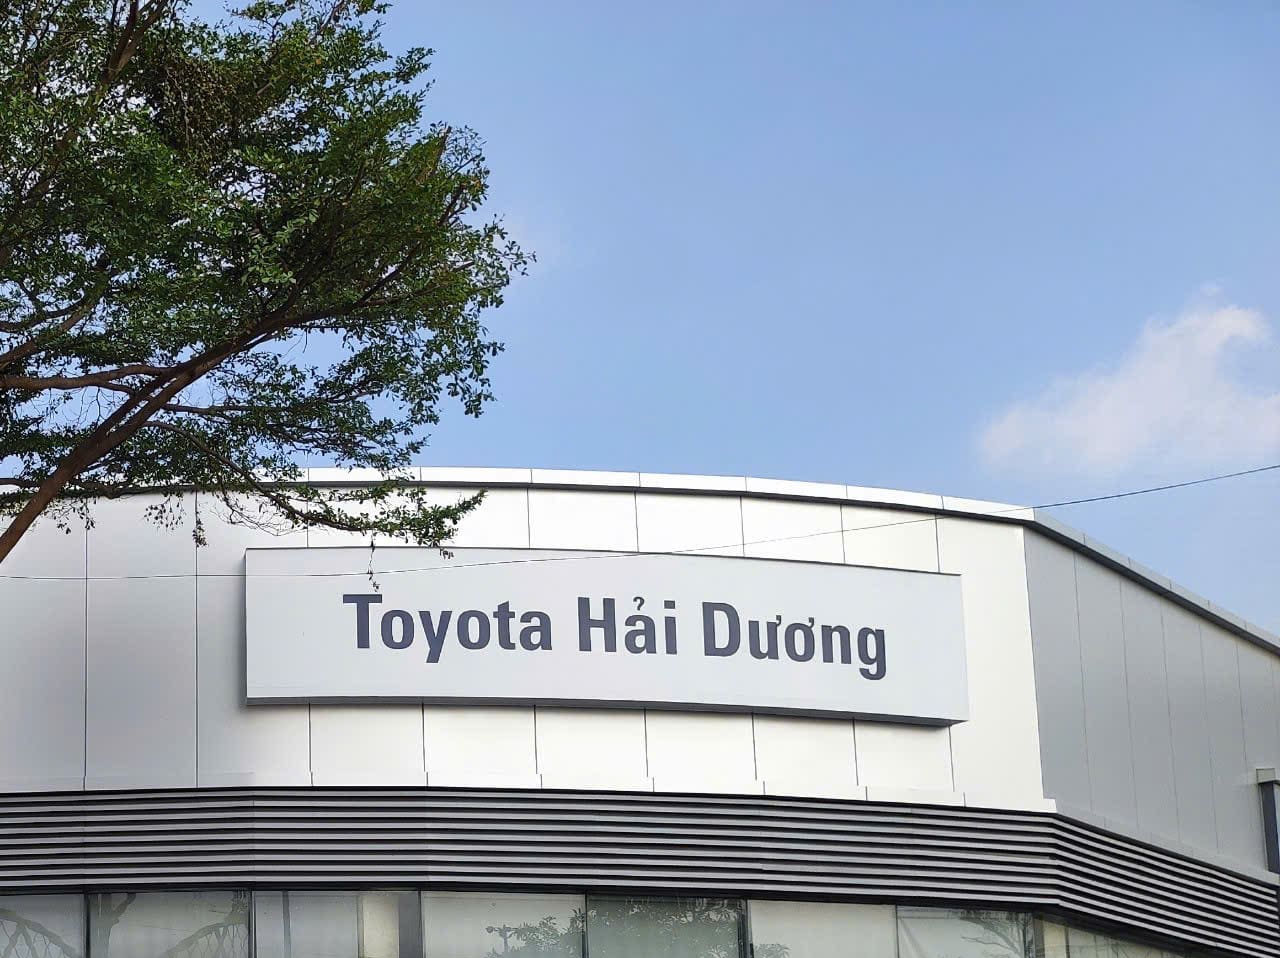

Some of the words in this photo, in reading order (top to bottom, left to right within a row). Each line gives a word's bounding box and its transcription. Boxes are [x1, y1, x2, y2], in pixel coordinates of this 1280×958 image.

[342, 593, 553, 664] Toyota
[577, 595, 678, 655] Hải
[701, 600, 888, 681] Dương
